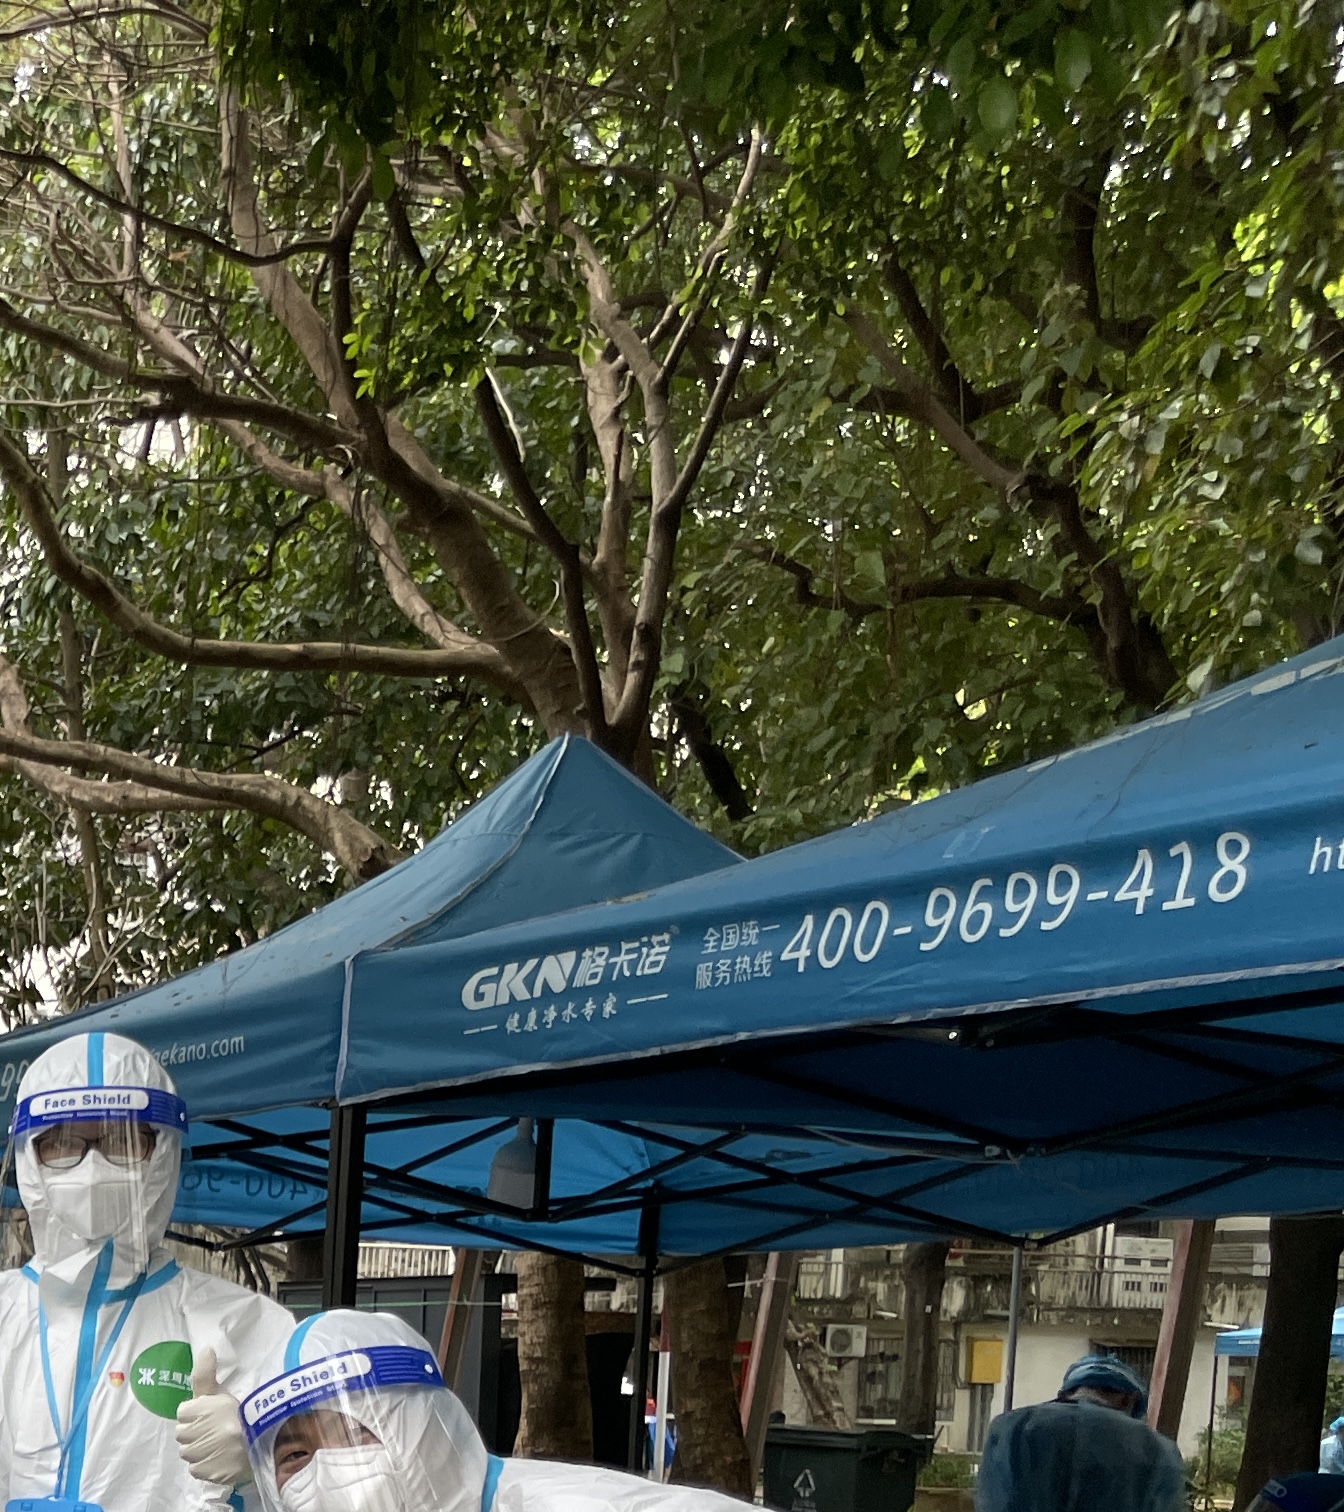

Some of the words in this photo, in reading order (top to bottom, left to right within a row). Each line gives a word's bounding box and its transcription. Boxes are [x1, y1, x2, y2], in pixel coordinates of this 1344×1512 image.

[780, 831, 1252, 973] 400-9699-418
[700, 920, 780, 955] 全国统一
[461, 950, 577, 1011] GKN
[572, 933, 672, 988] 格卡诺
[695, 951, 773, 990] 服务热线
[44, 1098, 76, 1110] Face
[82, 1094, 131, 1106] Shield
[254, 1388, 285, 1414] Face
[290, 1362, 348, 1392] Shield
